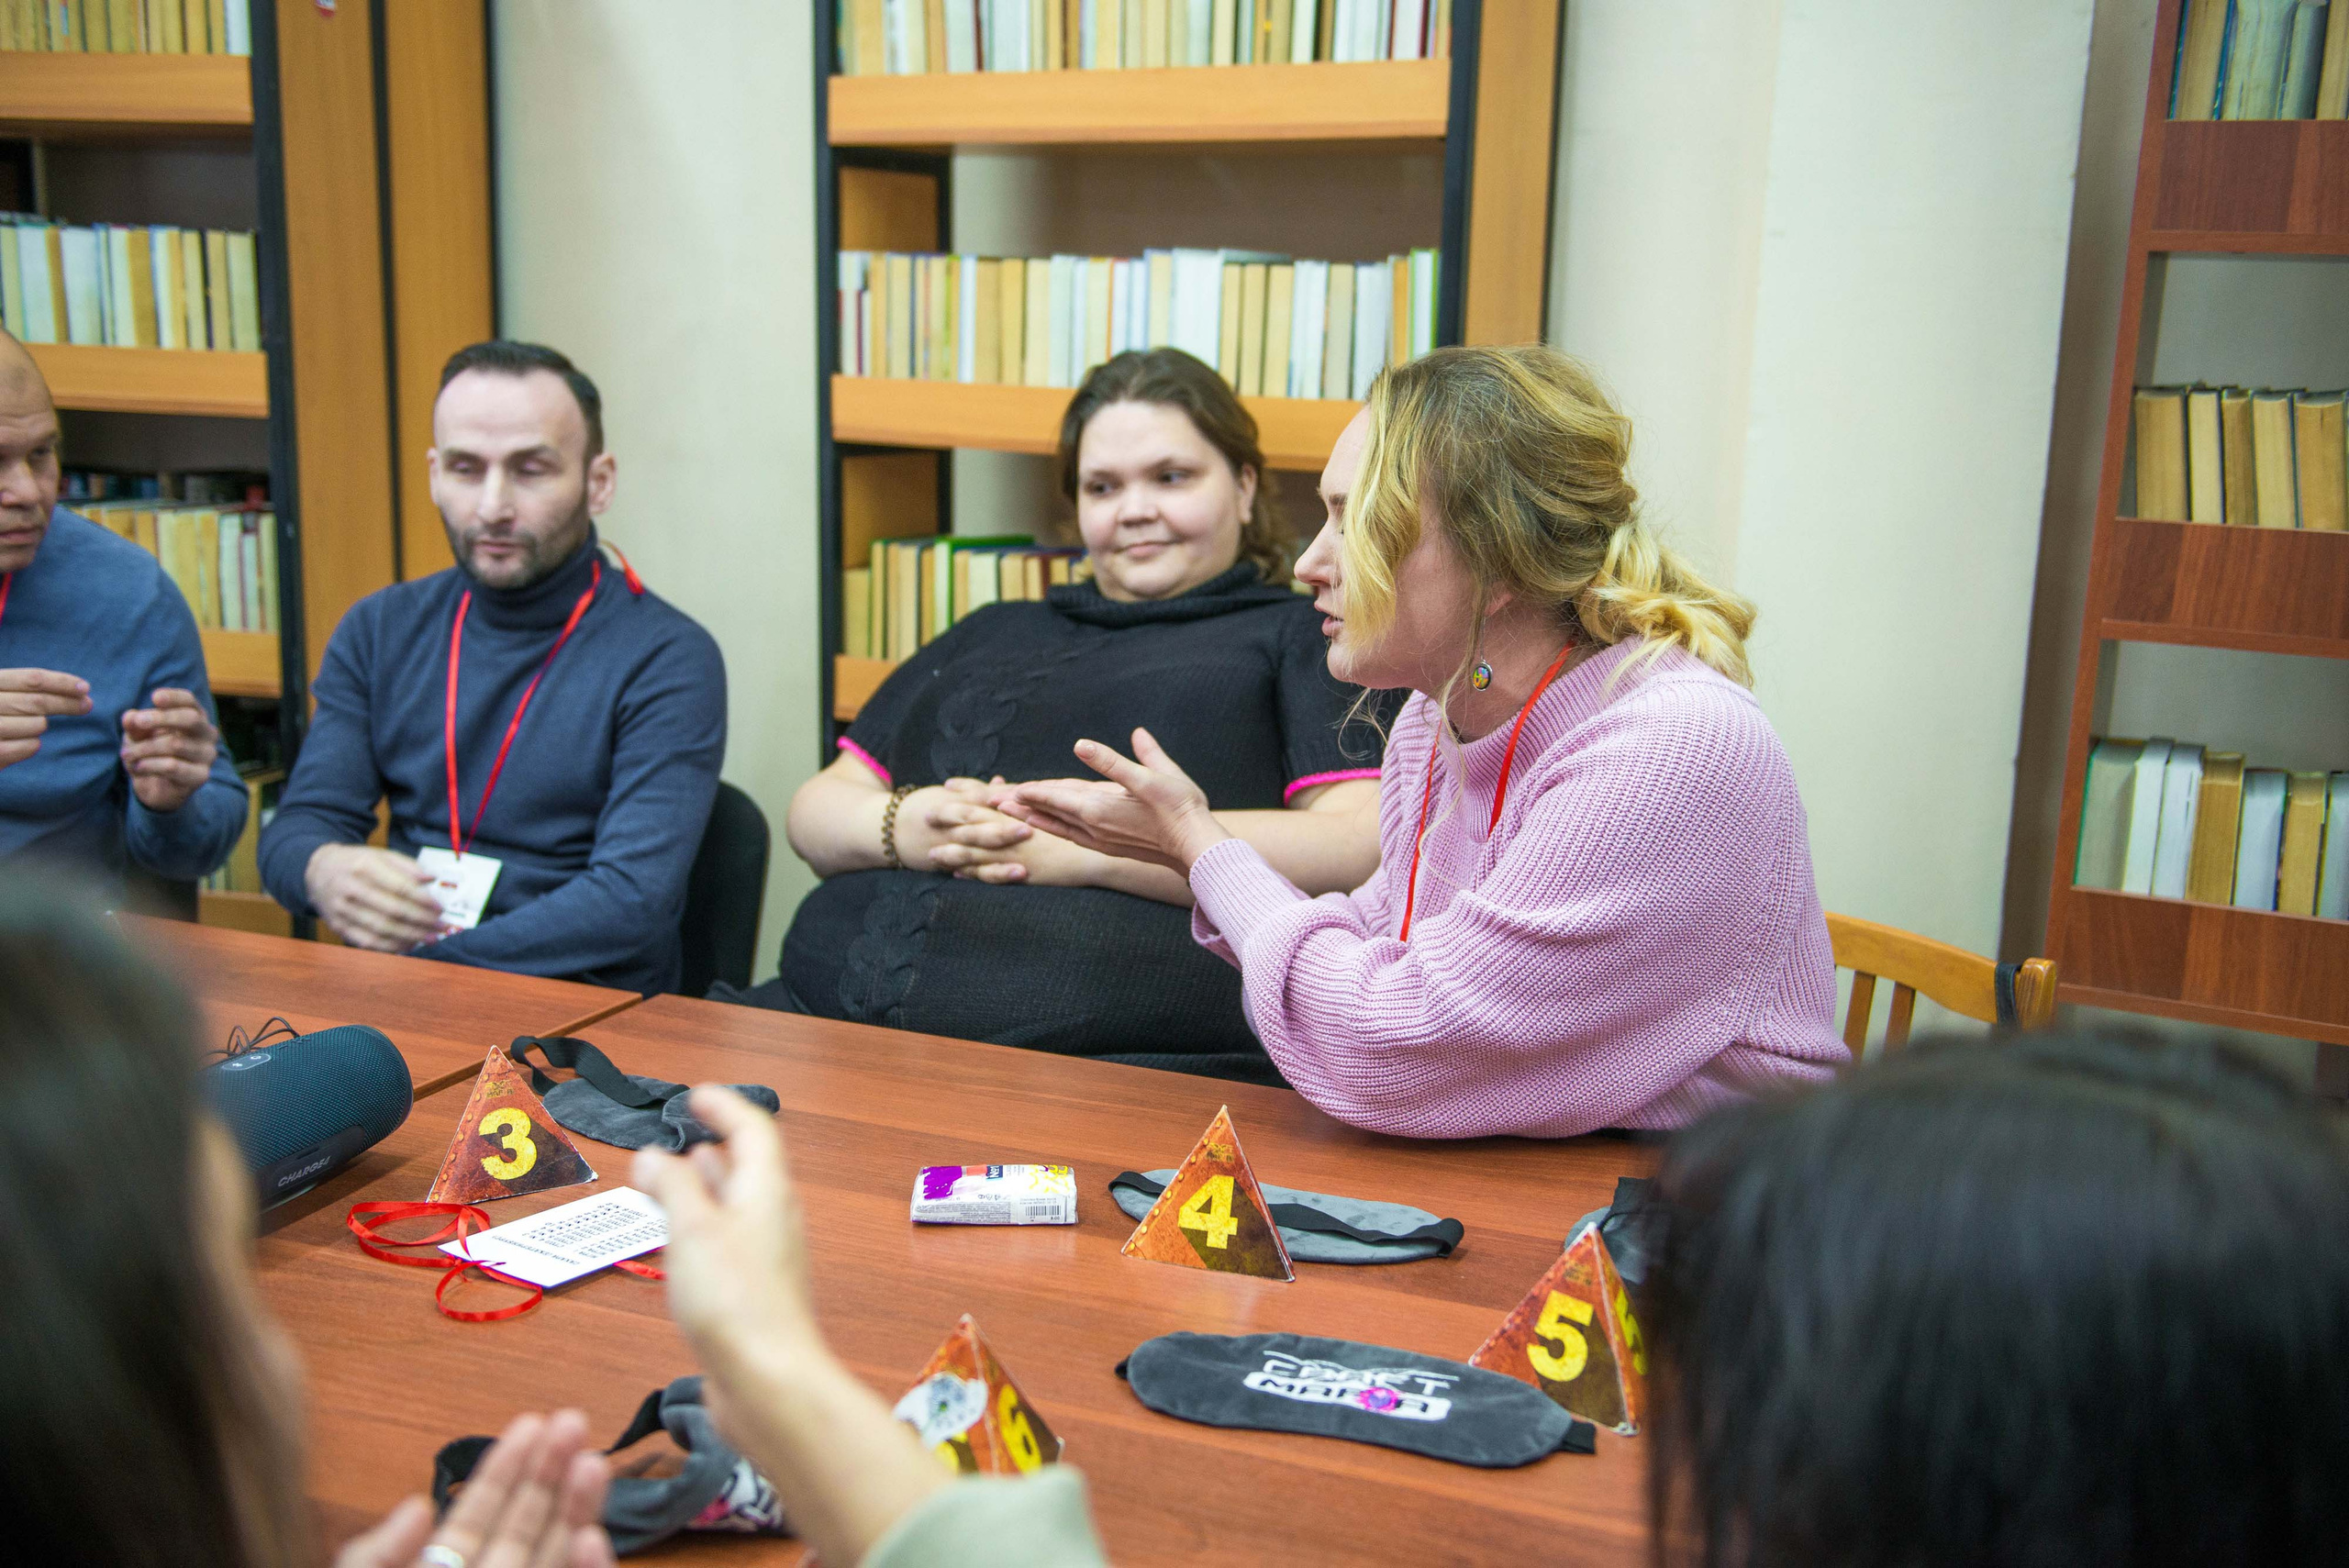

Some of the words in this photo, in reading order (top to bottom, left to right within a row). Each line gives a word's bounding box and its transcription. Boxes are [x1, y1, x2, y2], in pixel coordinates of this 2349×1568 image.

[478, 1107, 538, 1181] 3
[1177, 1174, 1239, 1250] 4
[1526, 1288, 1595, 1383] 5
[996, 1384, 1043, 1476] 6
[1259, 1379, 1431, 1414] MAFA
